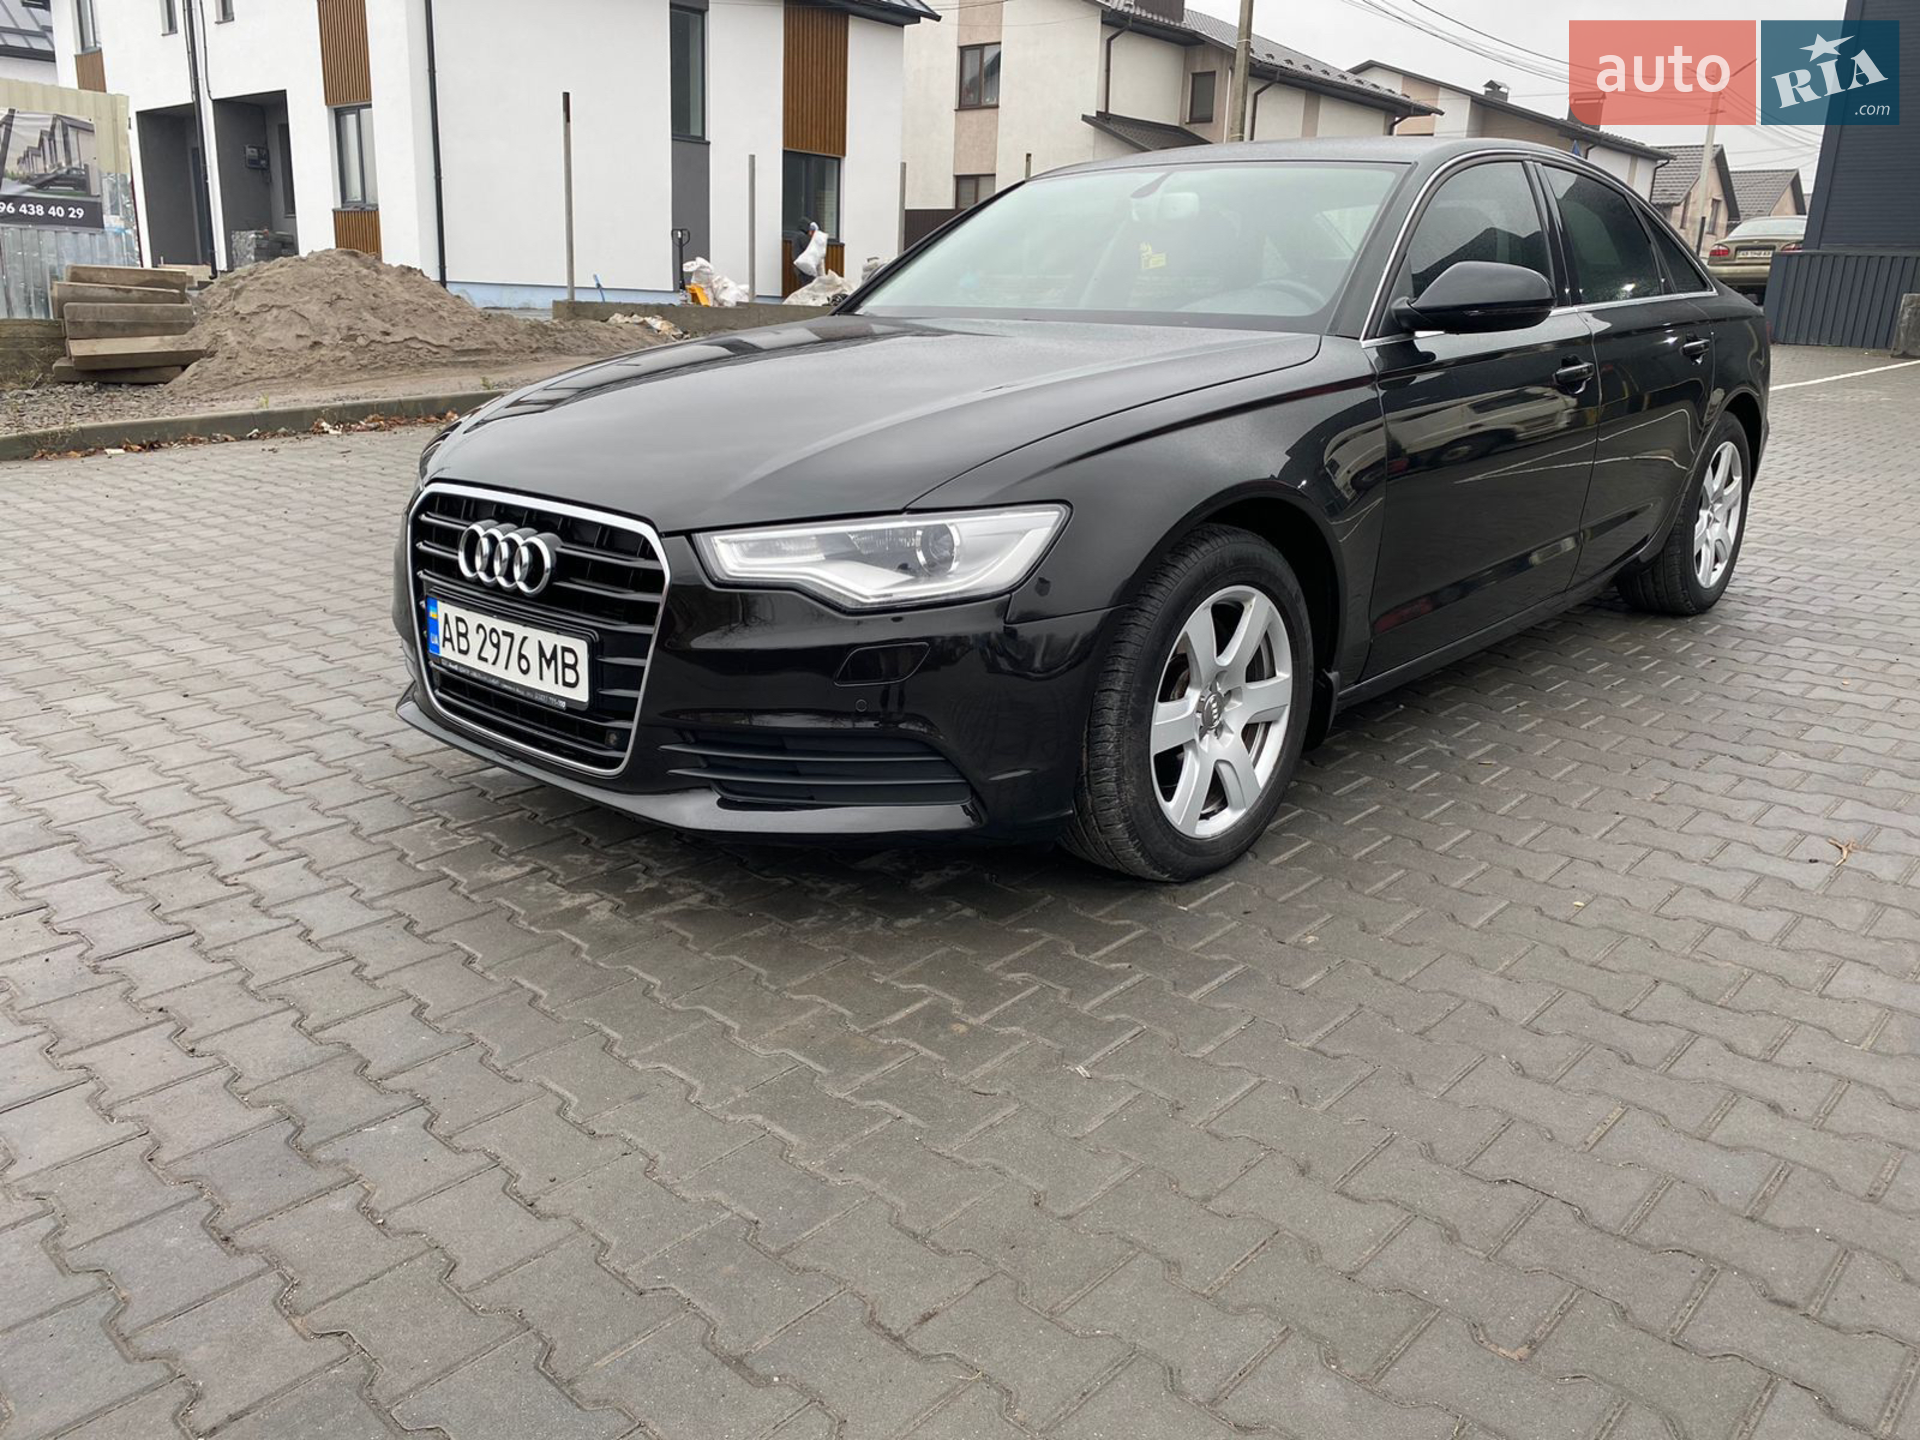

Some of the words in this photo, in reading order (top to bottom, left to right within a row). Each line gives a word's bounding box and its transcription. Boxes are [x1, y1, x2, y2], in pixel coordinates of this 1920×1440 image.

[0, 201, 15, 214] 96
[18, 203, 45, 217] 438
[47, 205, 65, 218] 40
[67, 206, 85, 219] 29
[442, 612, 470, 655] AB
[475, 623, 531, 675] 2976
[537, 639, 580, 689] MB
